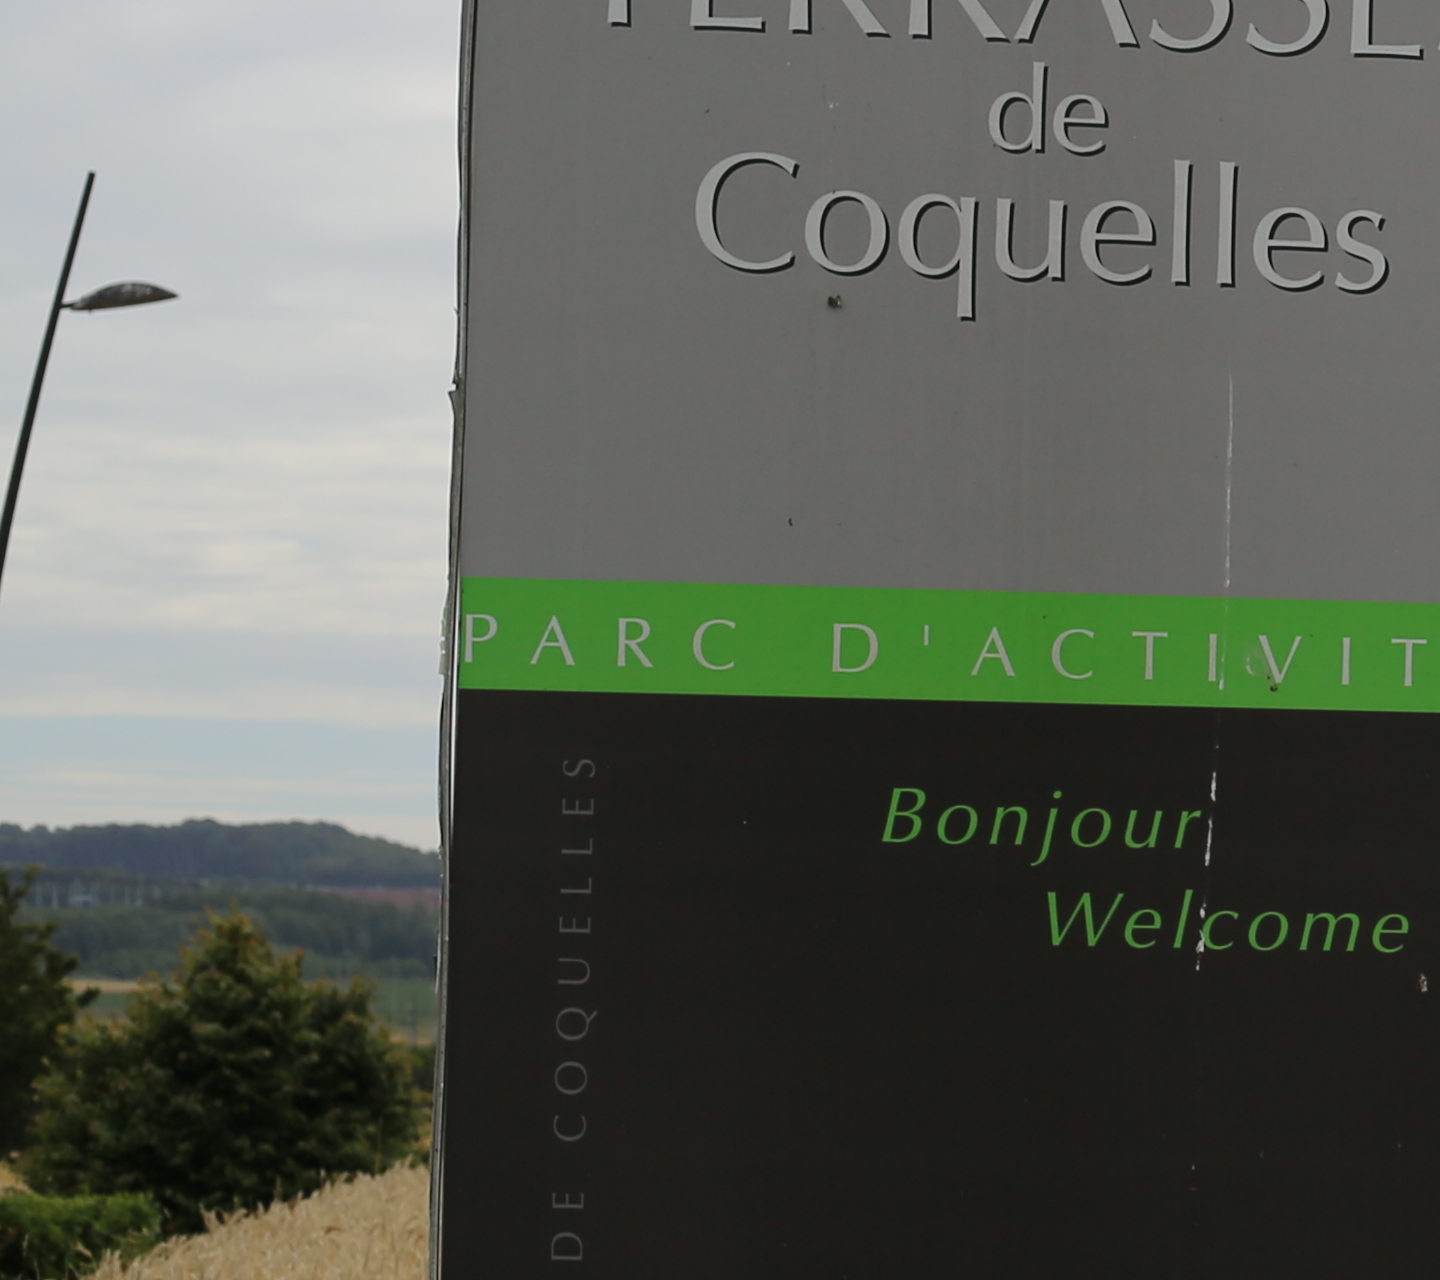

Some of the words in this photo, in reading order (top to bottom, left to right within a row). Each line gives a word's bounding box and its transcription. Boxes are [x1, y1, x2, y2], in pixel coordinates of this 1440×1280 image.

[987, 61, 1109, 156] de
[694, 151, 1391, 321] Coquelles
[463, 613, 737, 671] PARC
[881, 786, 1202, 867] Bonjour
[554, 756, 597, 1142] COQUELLES
[1045, 889, 1412, 954] Welcome
[550, 1191, 585, 1263] DE
